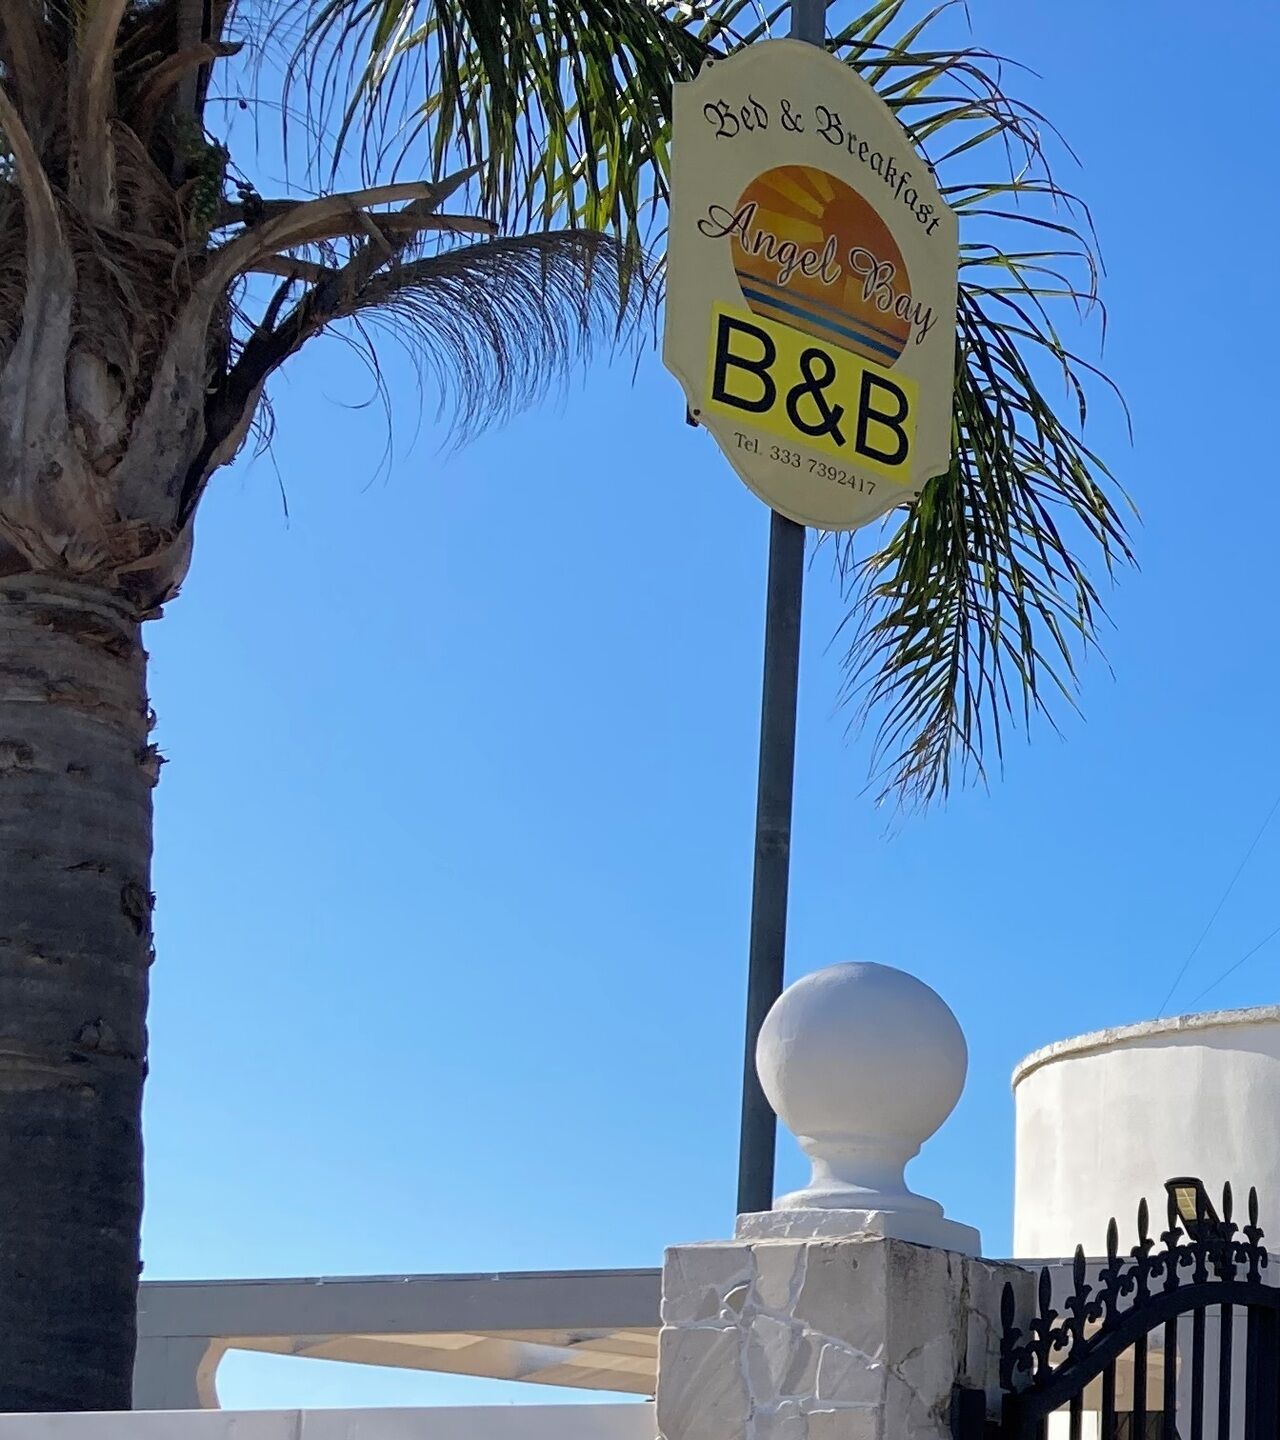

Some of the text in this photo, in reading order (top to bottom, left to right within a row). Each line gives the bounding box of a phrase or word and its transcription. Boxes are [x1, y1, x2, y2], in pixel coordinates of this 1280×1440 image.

[703, 95, 941, 236] Bed & Breakfast
[697, 202, 938, 344] Angel Bay
[711, 313, 910, 467] B&B
[734, 431, 876, 496] Tel. 333 7392417
